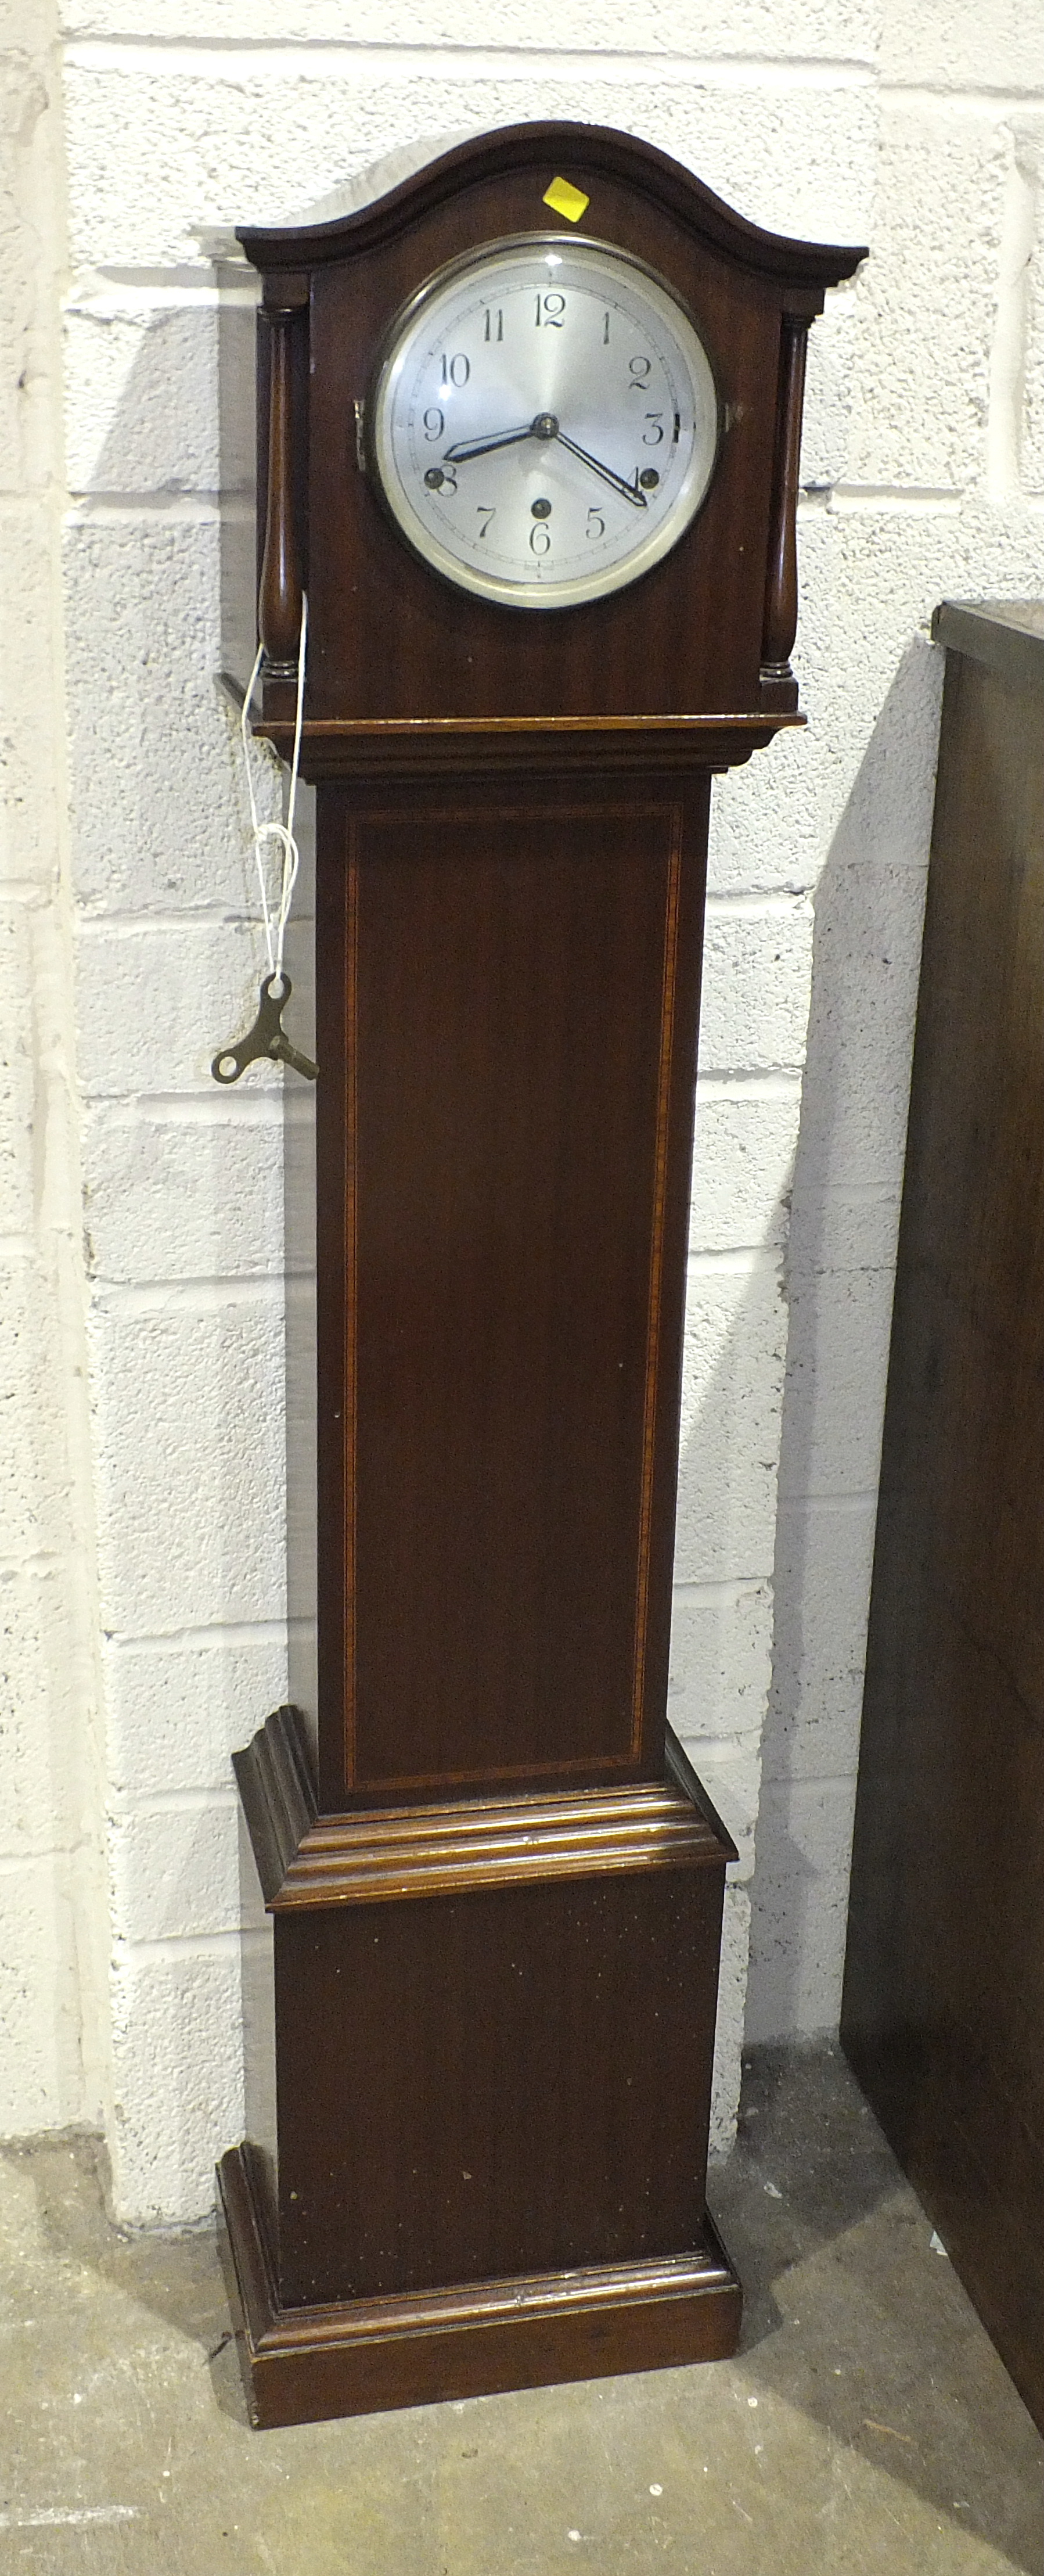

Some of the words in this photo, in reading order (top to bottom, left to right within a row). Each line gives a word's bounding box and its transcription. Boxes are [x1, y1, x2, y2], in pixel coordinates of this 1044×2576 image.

[484, 310, 503, 342] 11
[534, 294, 566, 328] 12
[602, 312, 610, 344] 1
[440, 353, 470, 387] 10
[628, 357, 651, 390] 2
[423, 408, 445, 441] 9
[642, 413, 664, 445] 3
[434, 464, 458, 498] 8
[476, 507, 496, 538] 7
[585, 508, 606, 539] 5
[529, 523, 551, 555] 6
